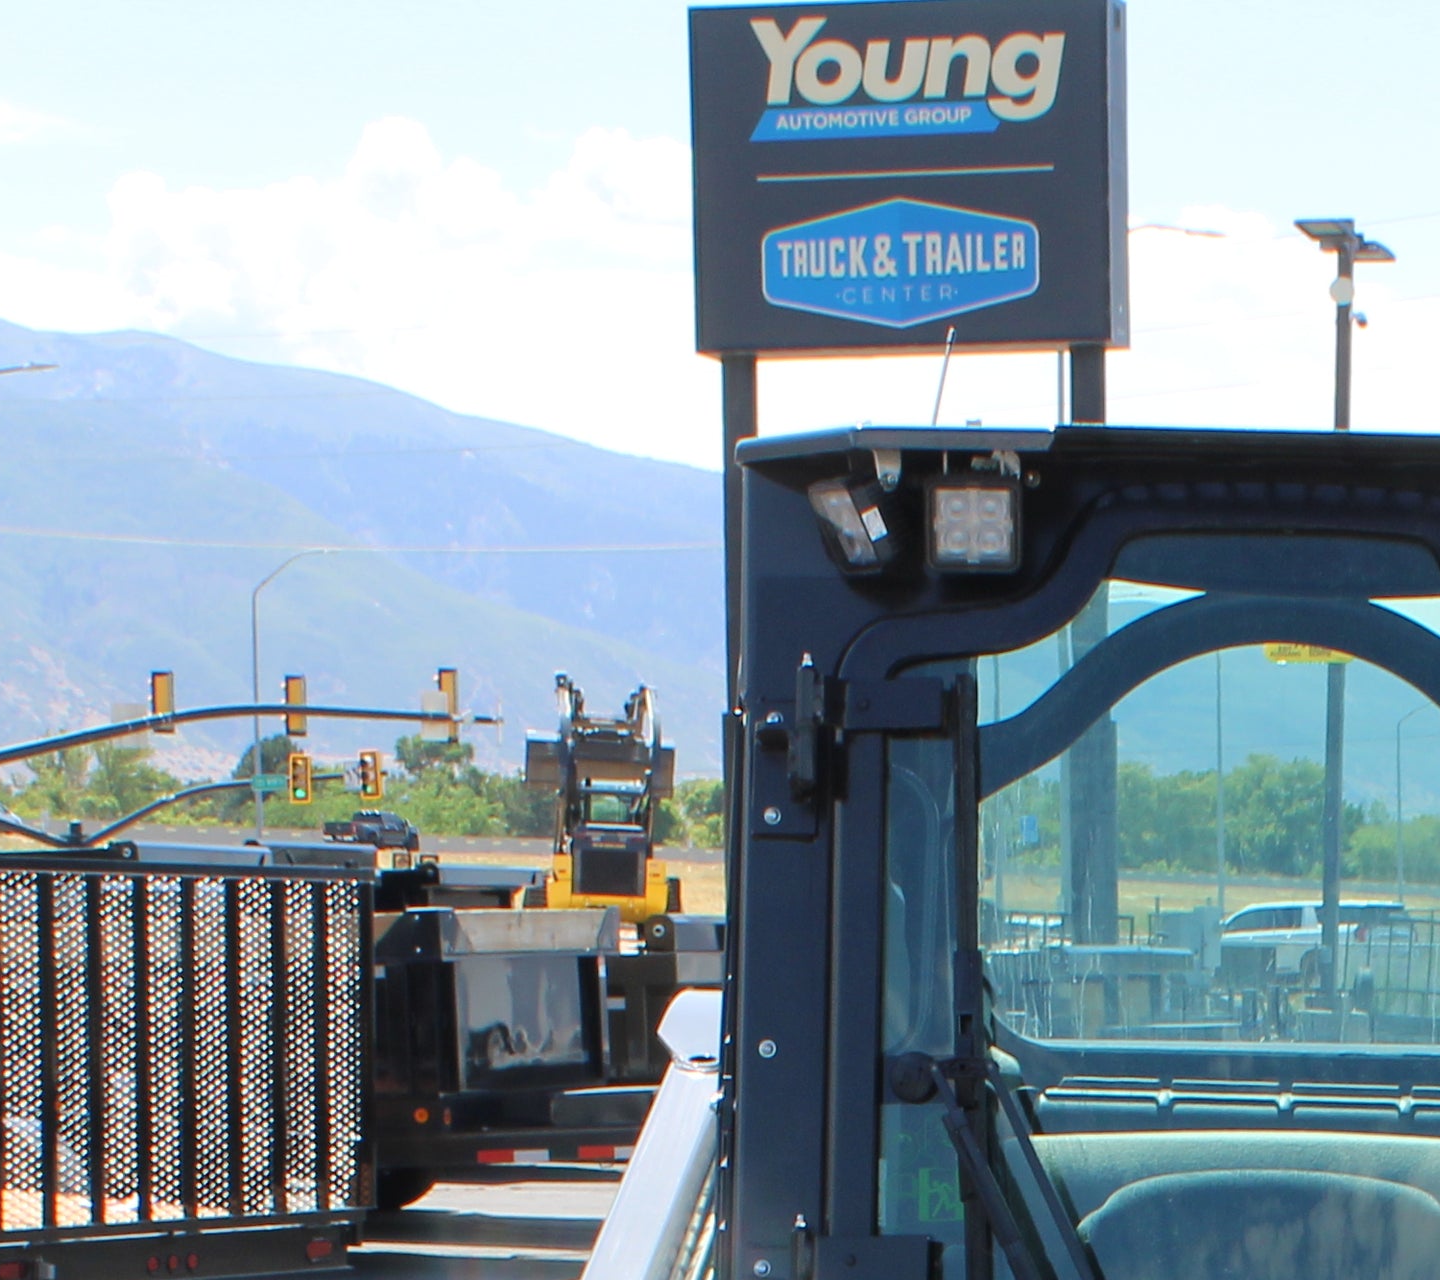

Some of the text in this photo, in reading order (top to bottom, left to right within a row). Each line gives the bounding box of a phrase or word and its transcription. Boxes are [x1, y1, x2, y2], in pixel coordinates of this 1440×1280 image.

[750, 16, 1065, 121] Young
[776, 107, 972, 131] AUTOMOTIVE GROUP
[778, 232, 1026, 279] TRUCK & TRAILER
[842, 284, 953, 306] CENTER
